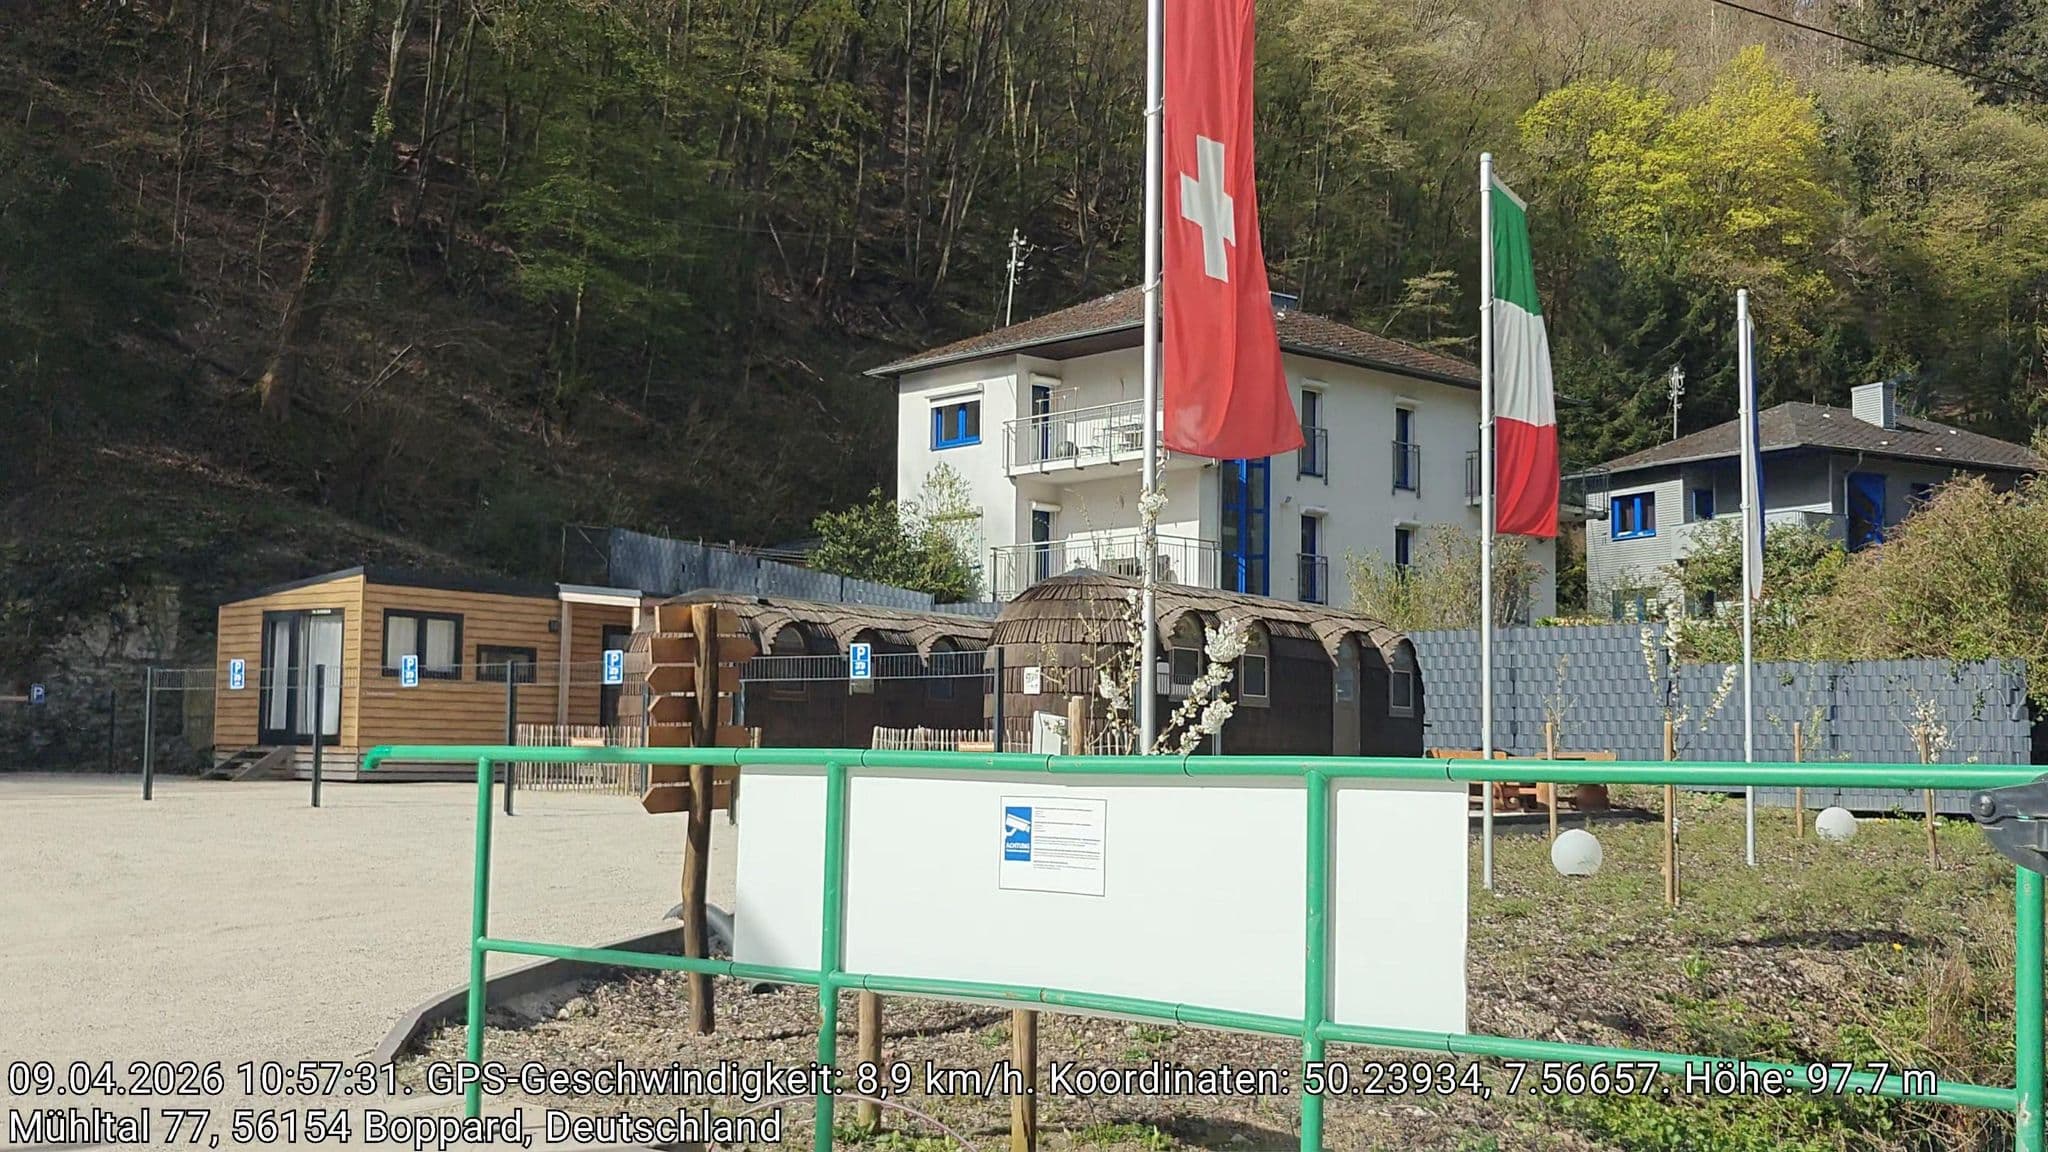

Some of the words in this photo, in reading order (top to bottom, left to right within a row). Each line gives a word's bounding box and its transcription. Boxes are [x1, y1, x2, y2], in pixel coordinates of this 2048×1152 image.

[610, 653, 619, 667] P
[856, 646, 866, 661] P
[235, 662, 241, 674] P
[407, 658, 414, 671] P
[33, 686, 43, 699] P
